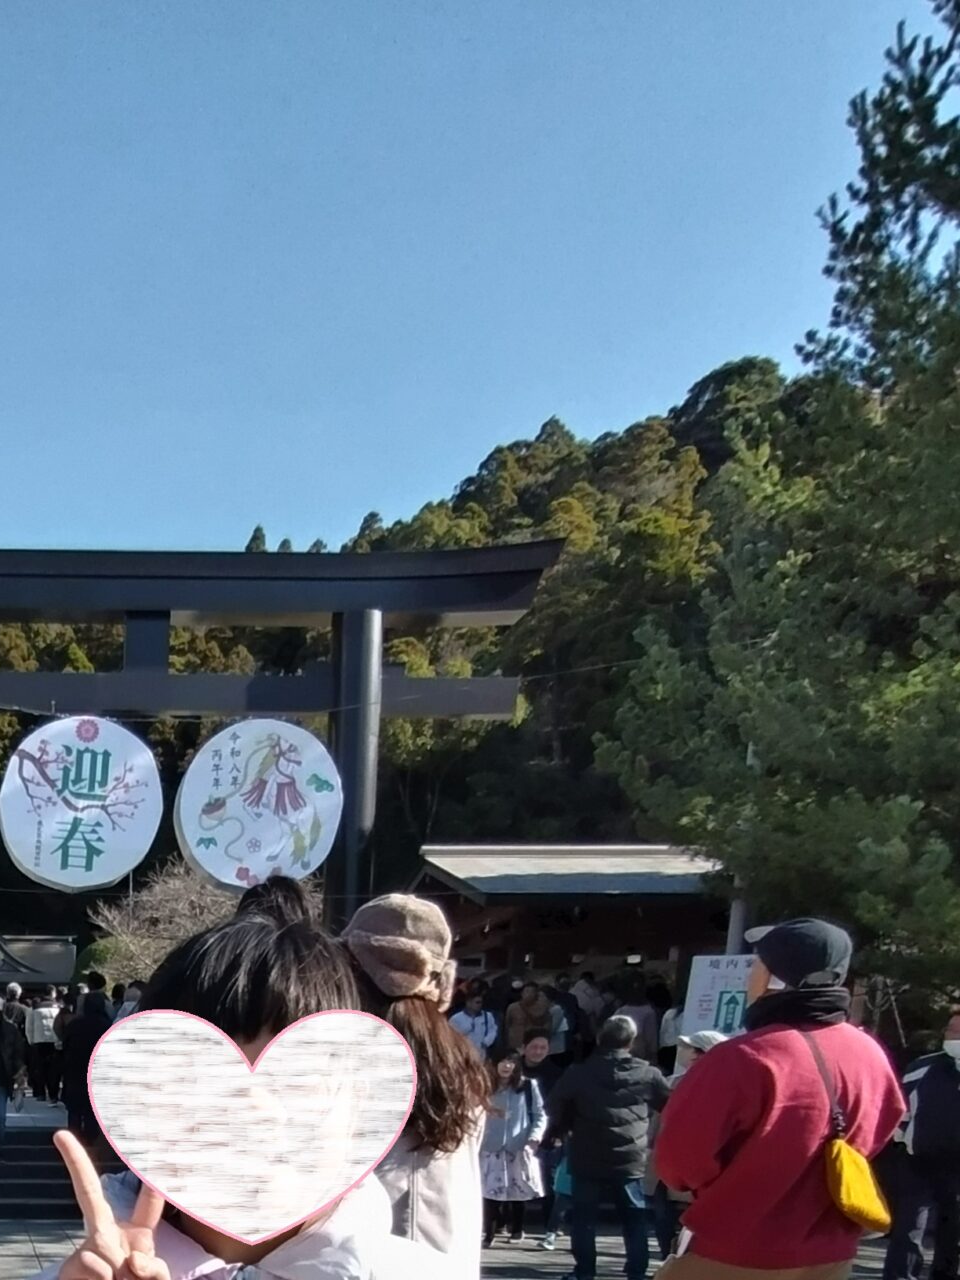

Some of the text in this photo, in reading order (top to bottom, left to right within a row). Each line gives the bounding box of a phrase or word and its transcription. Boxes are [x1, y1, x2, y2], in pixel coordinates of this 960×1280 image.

[211, 749, 223, 790] 丙午年
[229, 731, 242, 790] 令和八年
[50, 744, 112, 873] 迎春
